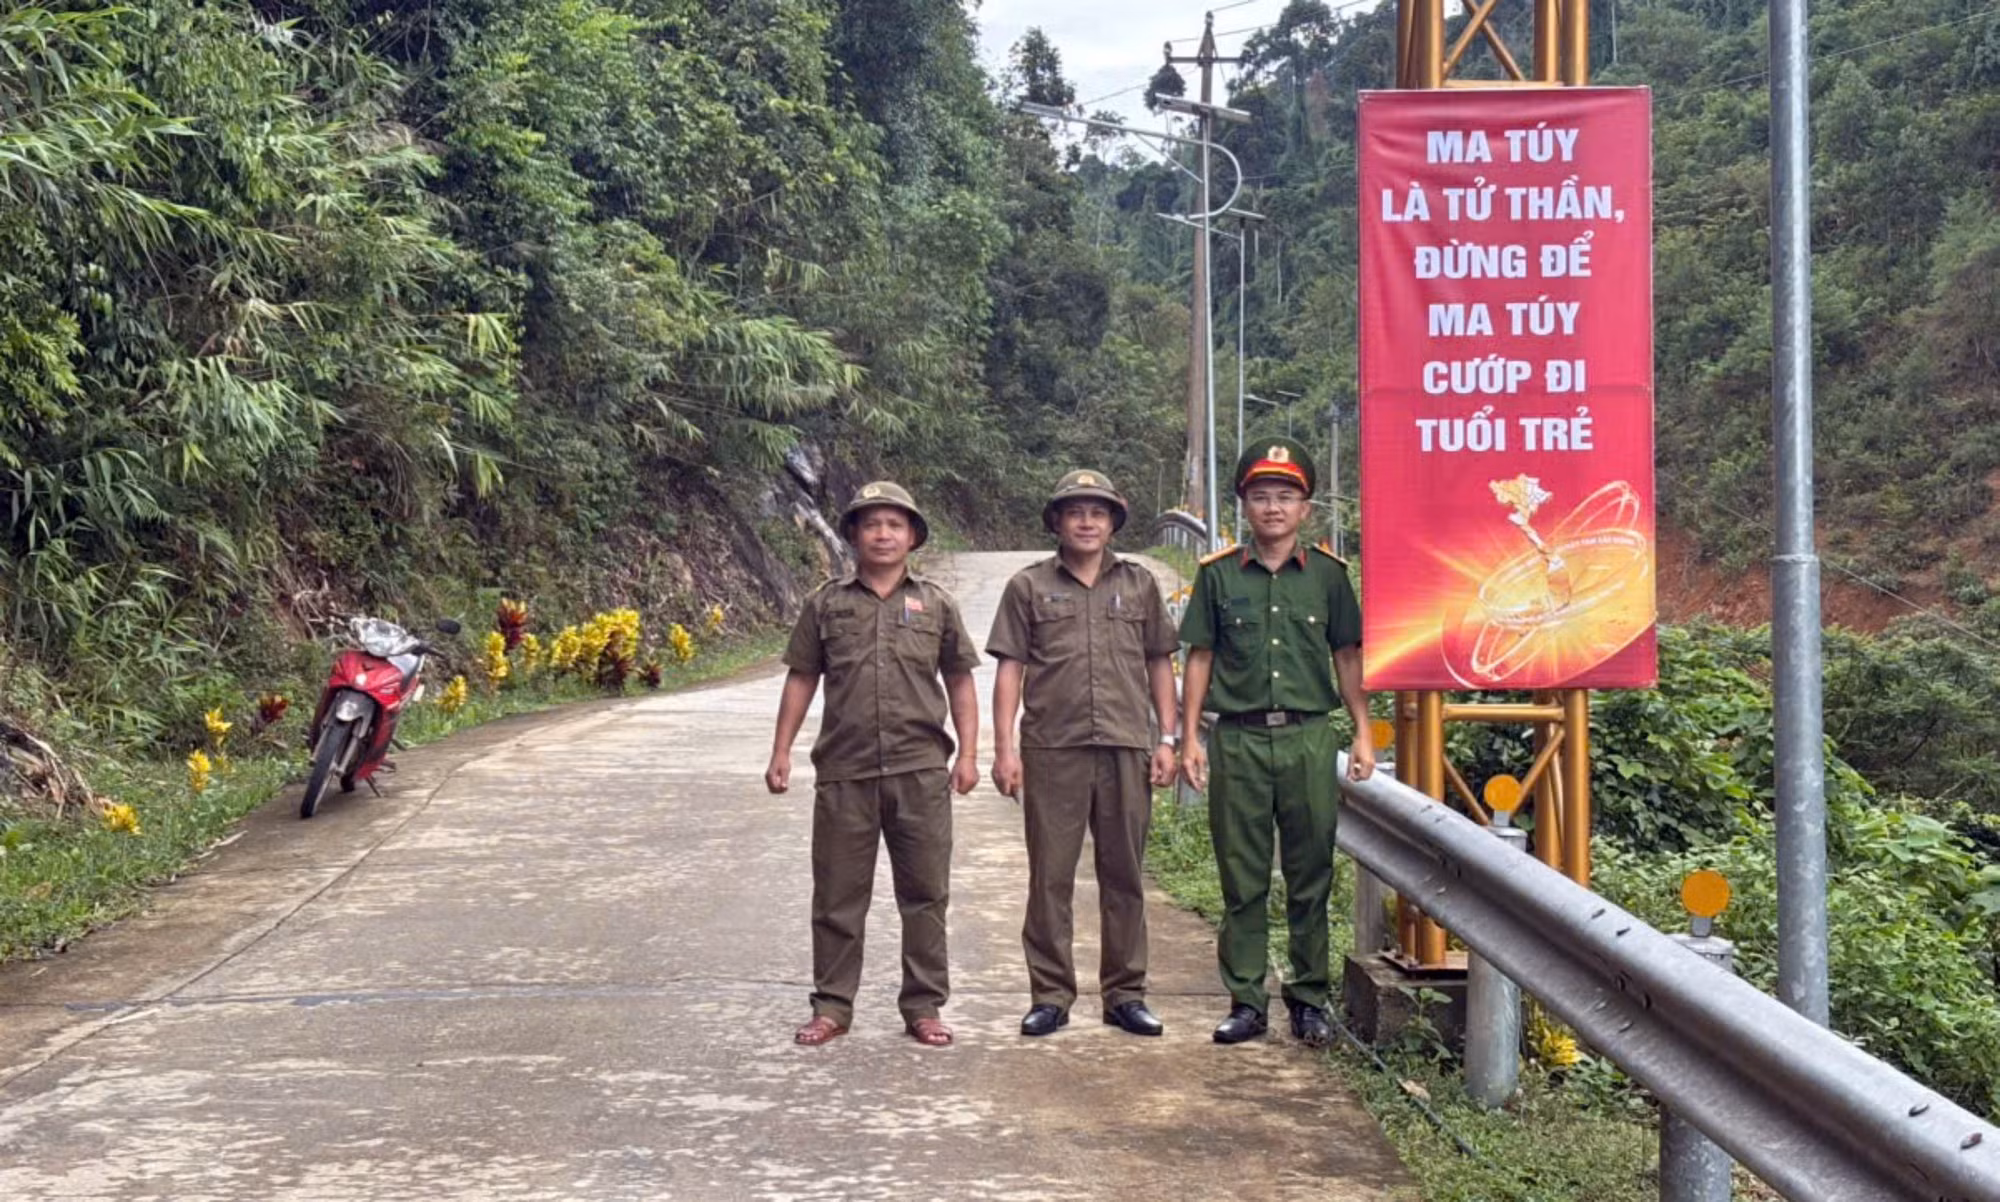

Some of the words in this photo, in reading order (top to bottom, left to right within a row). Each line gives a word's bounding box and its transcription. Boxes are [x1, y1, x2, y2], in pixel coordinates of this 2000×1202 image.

[1427, 130, 1492, 164] MA
[1504, 122, 1579, 163] TÚY
[1382, 182, 1430, 222] LÀ
[1443, 176, 1496, 221] TỬ
[1505, 175, 1624, 224] THẦN,
[1414, 239, 1527, 279] ĐỪNG
[1539, 230, 1594, 278] ĐỂ
[1429, 303, 1494, 336] MA
[1506, 295, 1580, 335] TÚY
[1423, 353, 1531, 394] CƯỚP
[1544, 360, 1585, 393] ĐI
[1416, 405, 1505, 452] TUỔI
[1520, 407, 1592, 451] TRẺ
